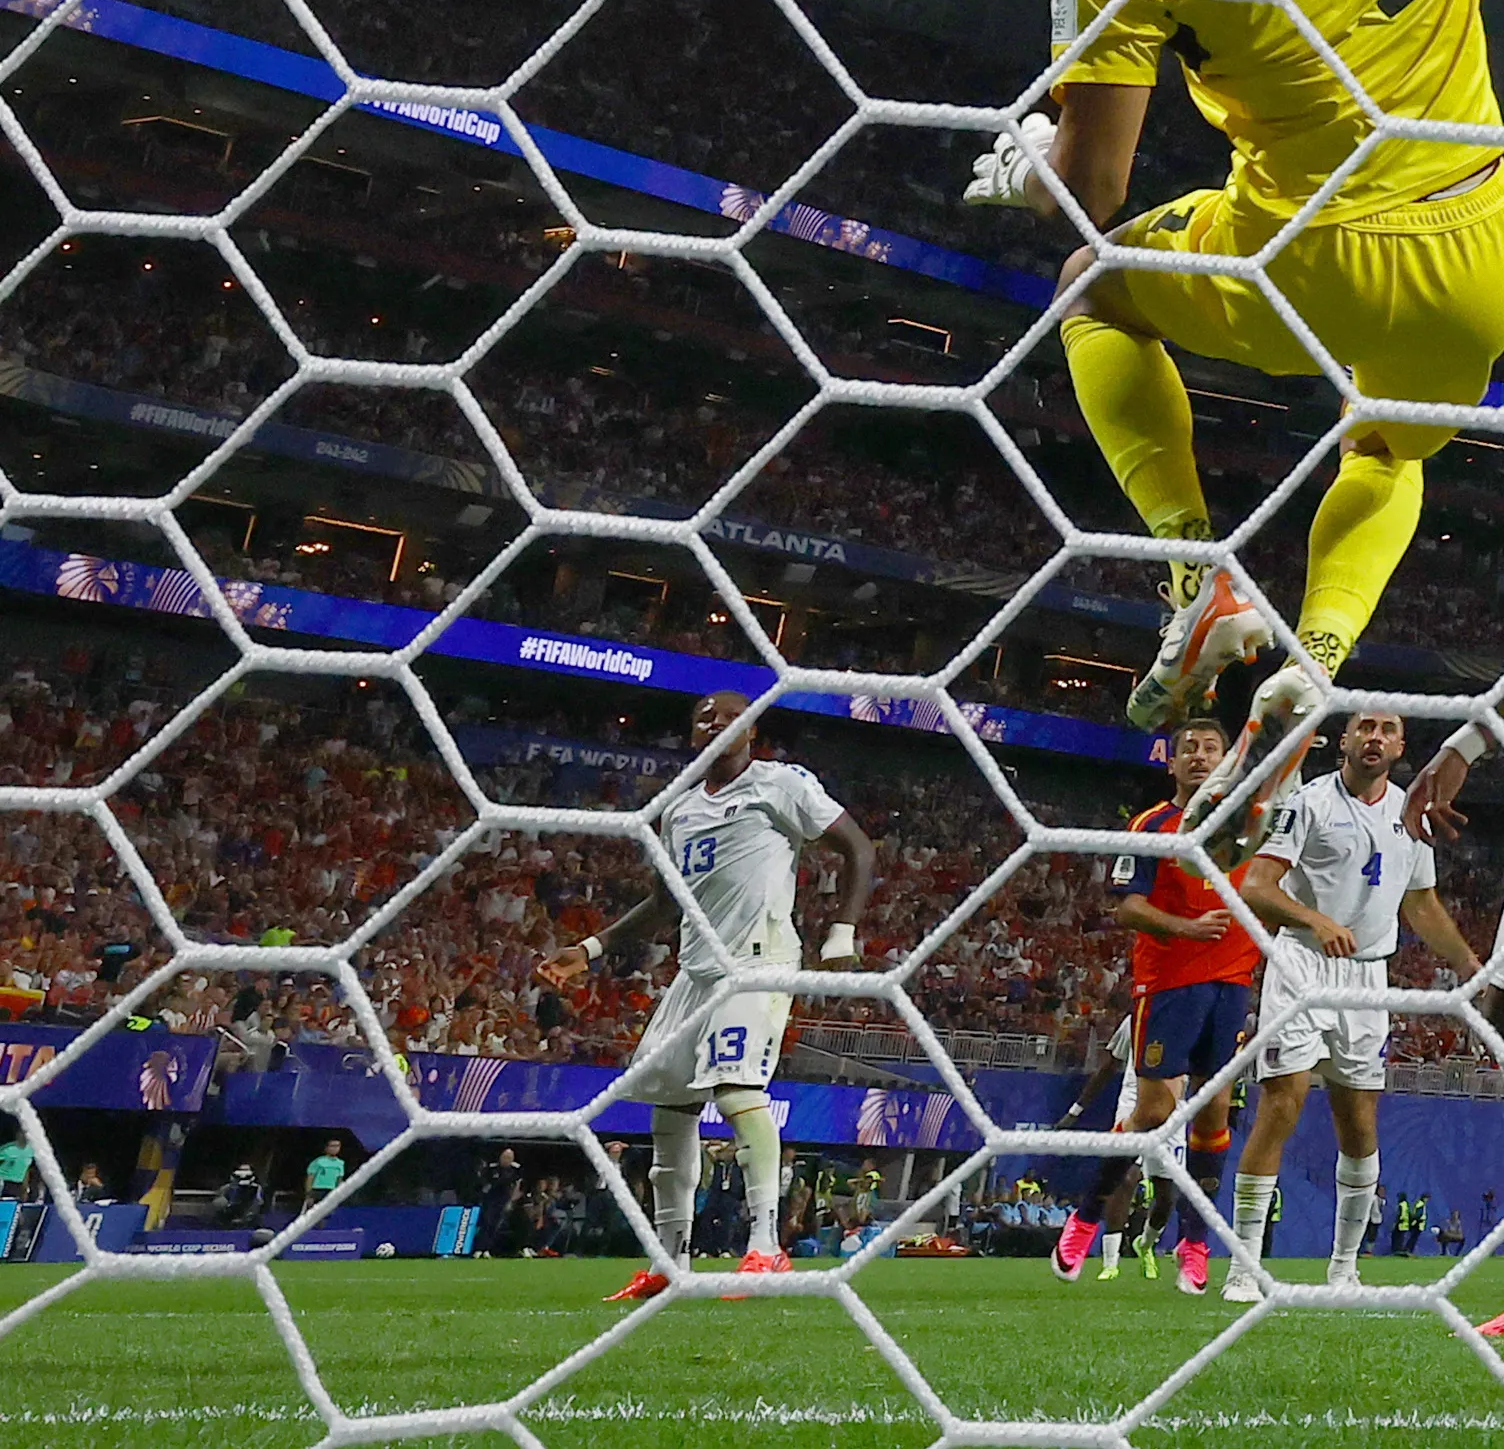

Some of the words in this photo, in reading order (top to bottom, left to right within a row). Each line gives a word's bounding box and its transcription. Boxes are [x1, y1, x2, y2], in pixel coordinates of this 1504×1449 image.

[702, 518, 847, 563] ATLANTA
[519, 636, 653, 682] #FIFAWorldCup
[682, 837, 717, 876] 13
[1361, 851, 1383, 887] 4
[706, 1026, 748, 1067] 13
